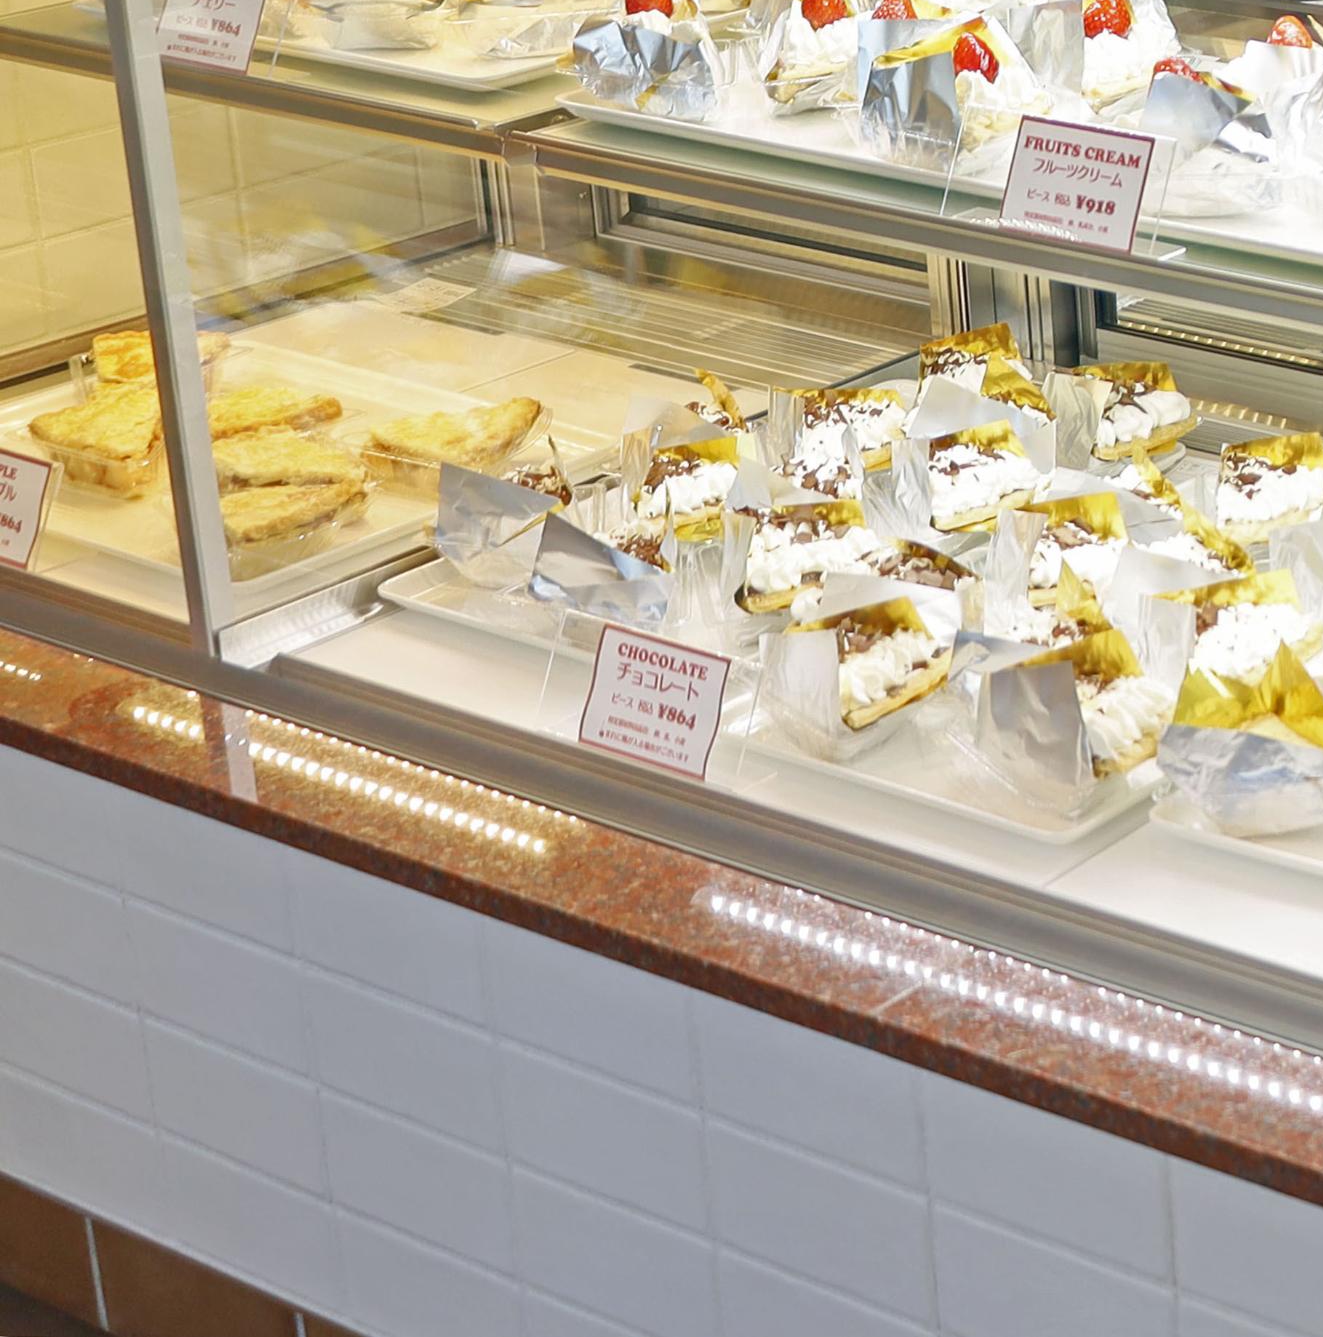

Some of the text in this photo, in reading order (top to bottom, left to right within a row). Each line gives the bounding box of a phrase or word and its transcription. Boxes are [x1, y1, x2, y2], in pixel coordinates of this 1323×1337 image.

[210, 18, 242, 37] ¥864
[1023, 135, 1142, 168] FRUITS CREAM
[1031, 157, 1123, 188] フルーツクリーム
[1076, 193, 1116, 215] ¥918
[617, 642, 709, 681] CHOCOLATE
[616, 662, 699, 701] チョコレート
[657, 702, 697, 731] ¥864
